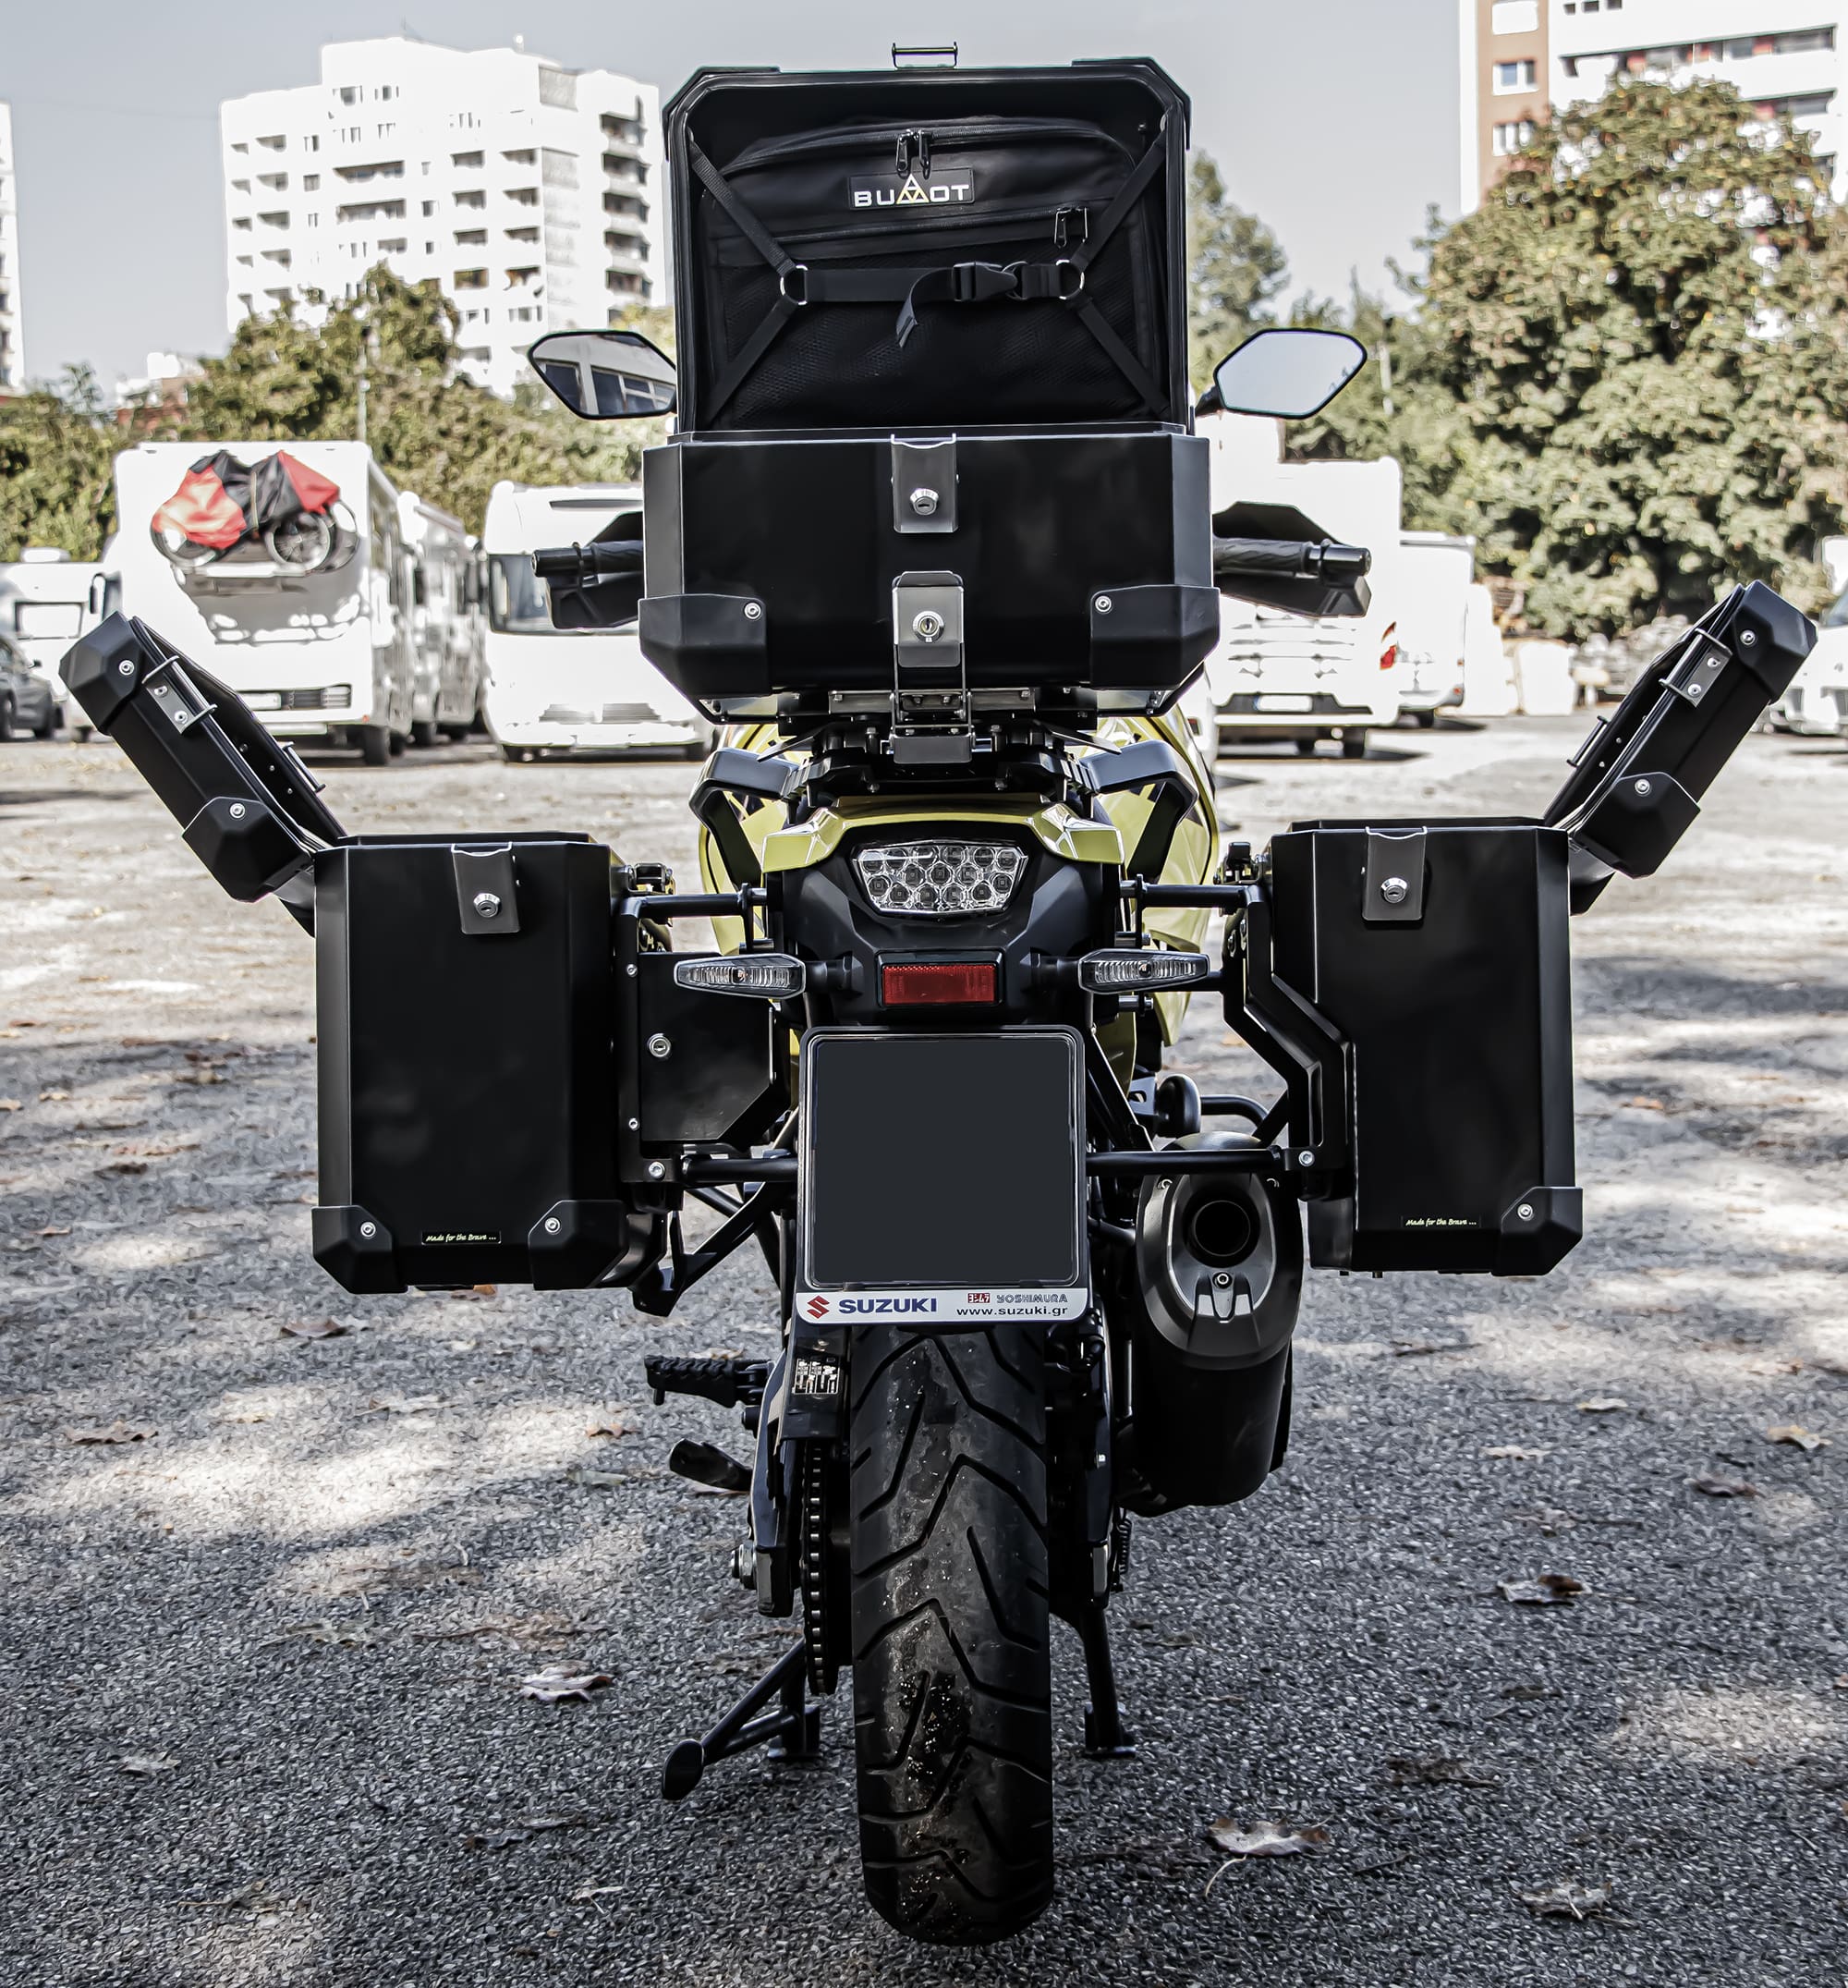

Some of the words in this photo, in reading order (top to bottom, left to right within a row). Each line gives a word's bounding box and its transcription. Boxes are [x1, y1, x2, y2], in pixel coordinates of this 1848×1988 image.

[1426, 1218, 1436, 1226] for
[445, 1233, 456, 1242] for
[996, 1293, 1068, 1303] YOSHIMURA
[838, 1298, 937, 1314] SUZUKI
[956, 1306, 1068, 1317] www.suzuki.gr
